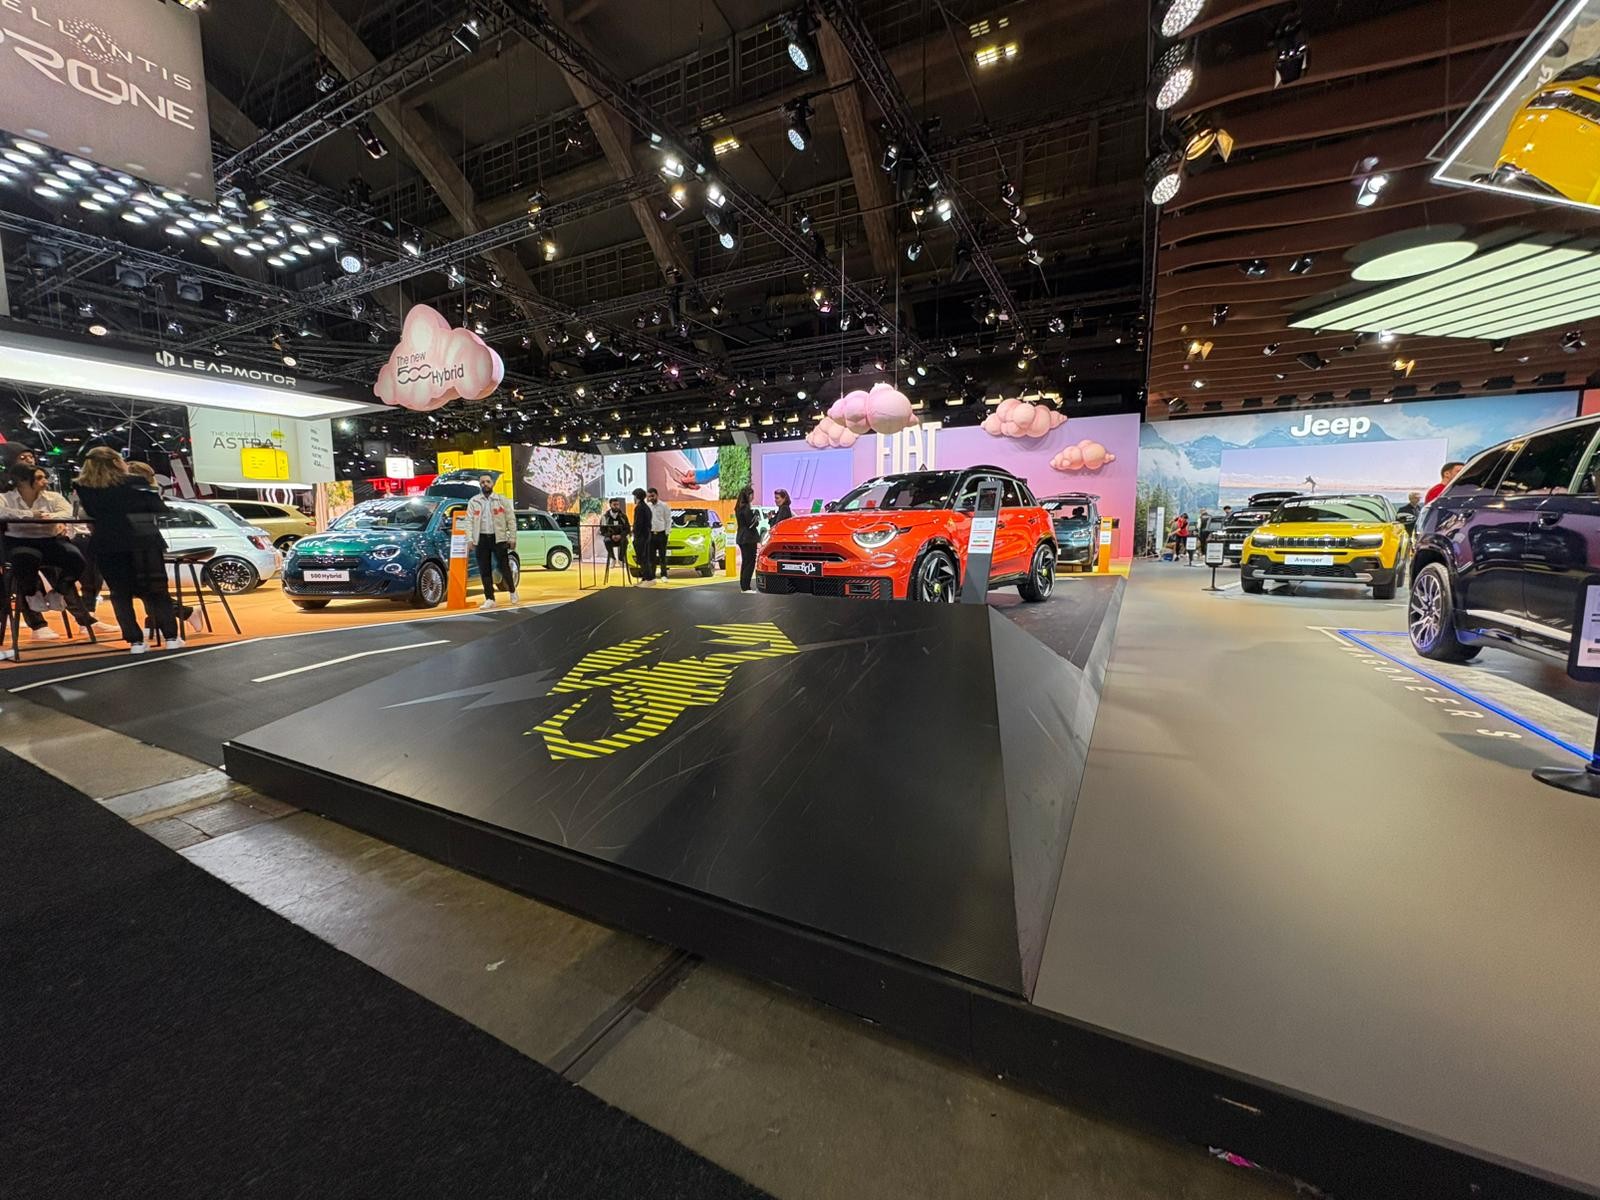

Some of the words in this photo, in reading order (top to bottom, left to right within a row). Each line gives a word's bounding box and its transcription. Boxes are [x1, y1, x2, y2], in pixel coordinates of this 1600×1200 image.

[397, 356, 409, 366] The
[410, 352, 427, 364] new
[180, 357, 297, 387] LEAPMOTOR
[397, 364, 431, 385] 500
[432, 363, 464, 387] Hybrid
[1290, 414, 1371, 438] Jeep
[213, 436, 274, 450] ASTRA
[876, 421, 942, 478] FIAT
[1294, 555, 1323, 563] Avenger
